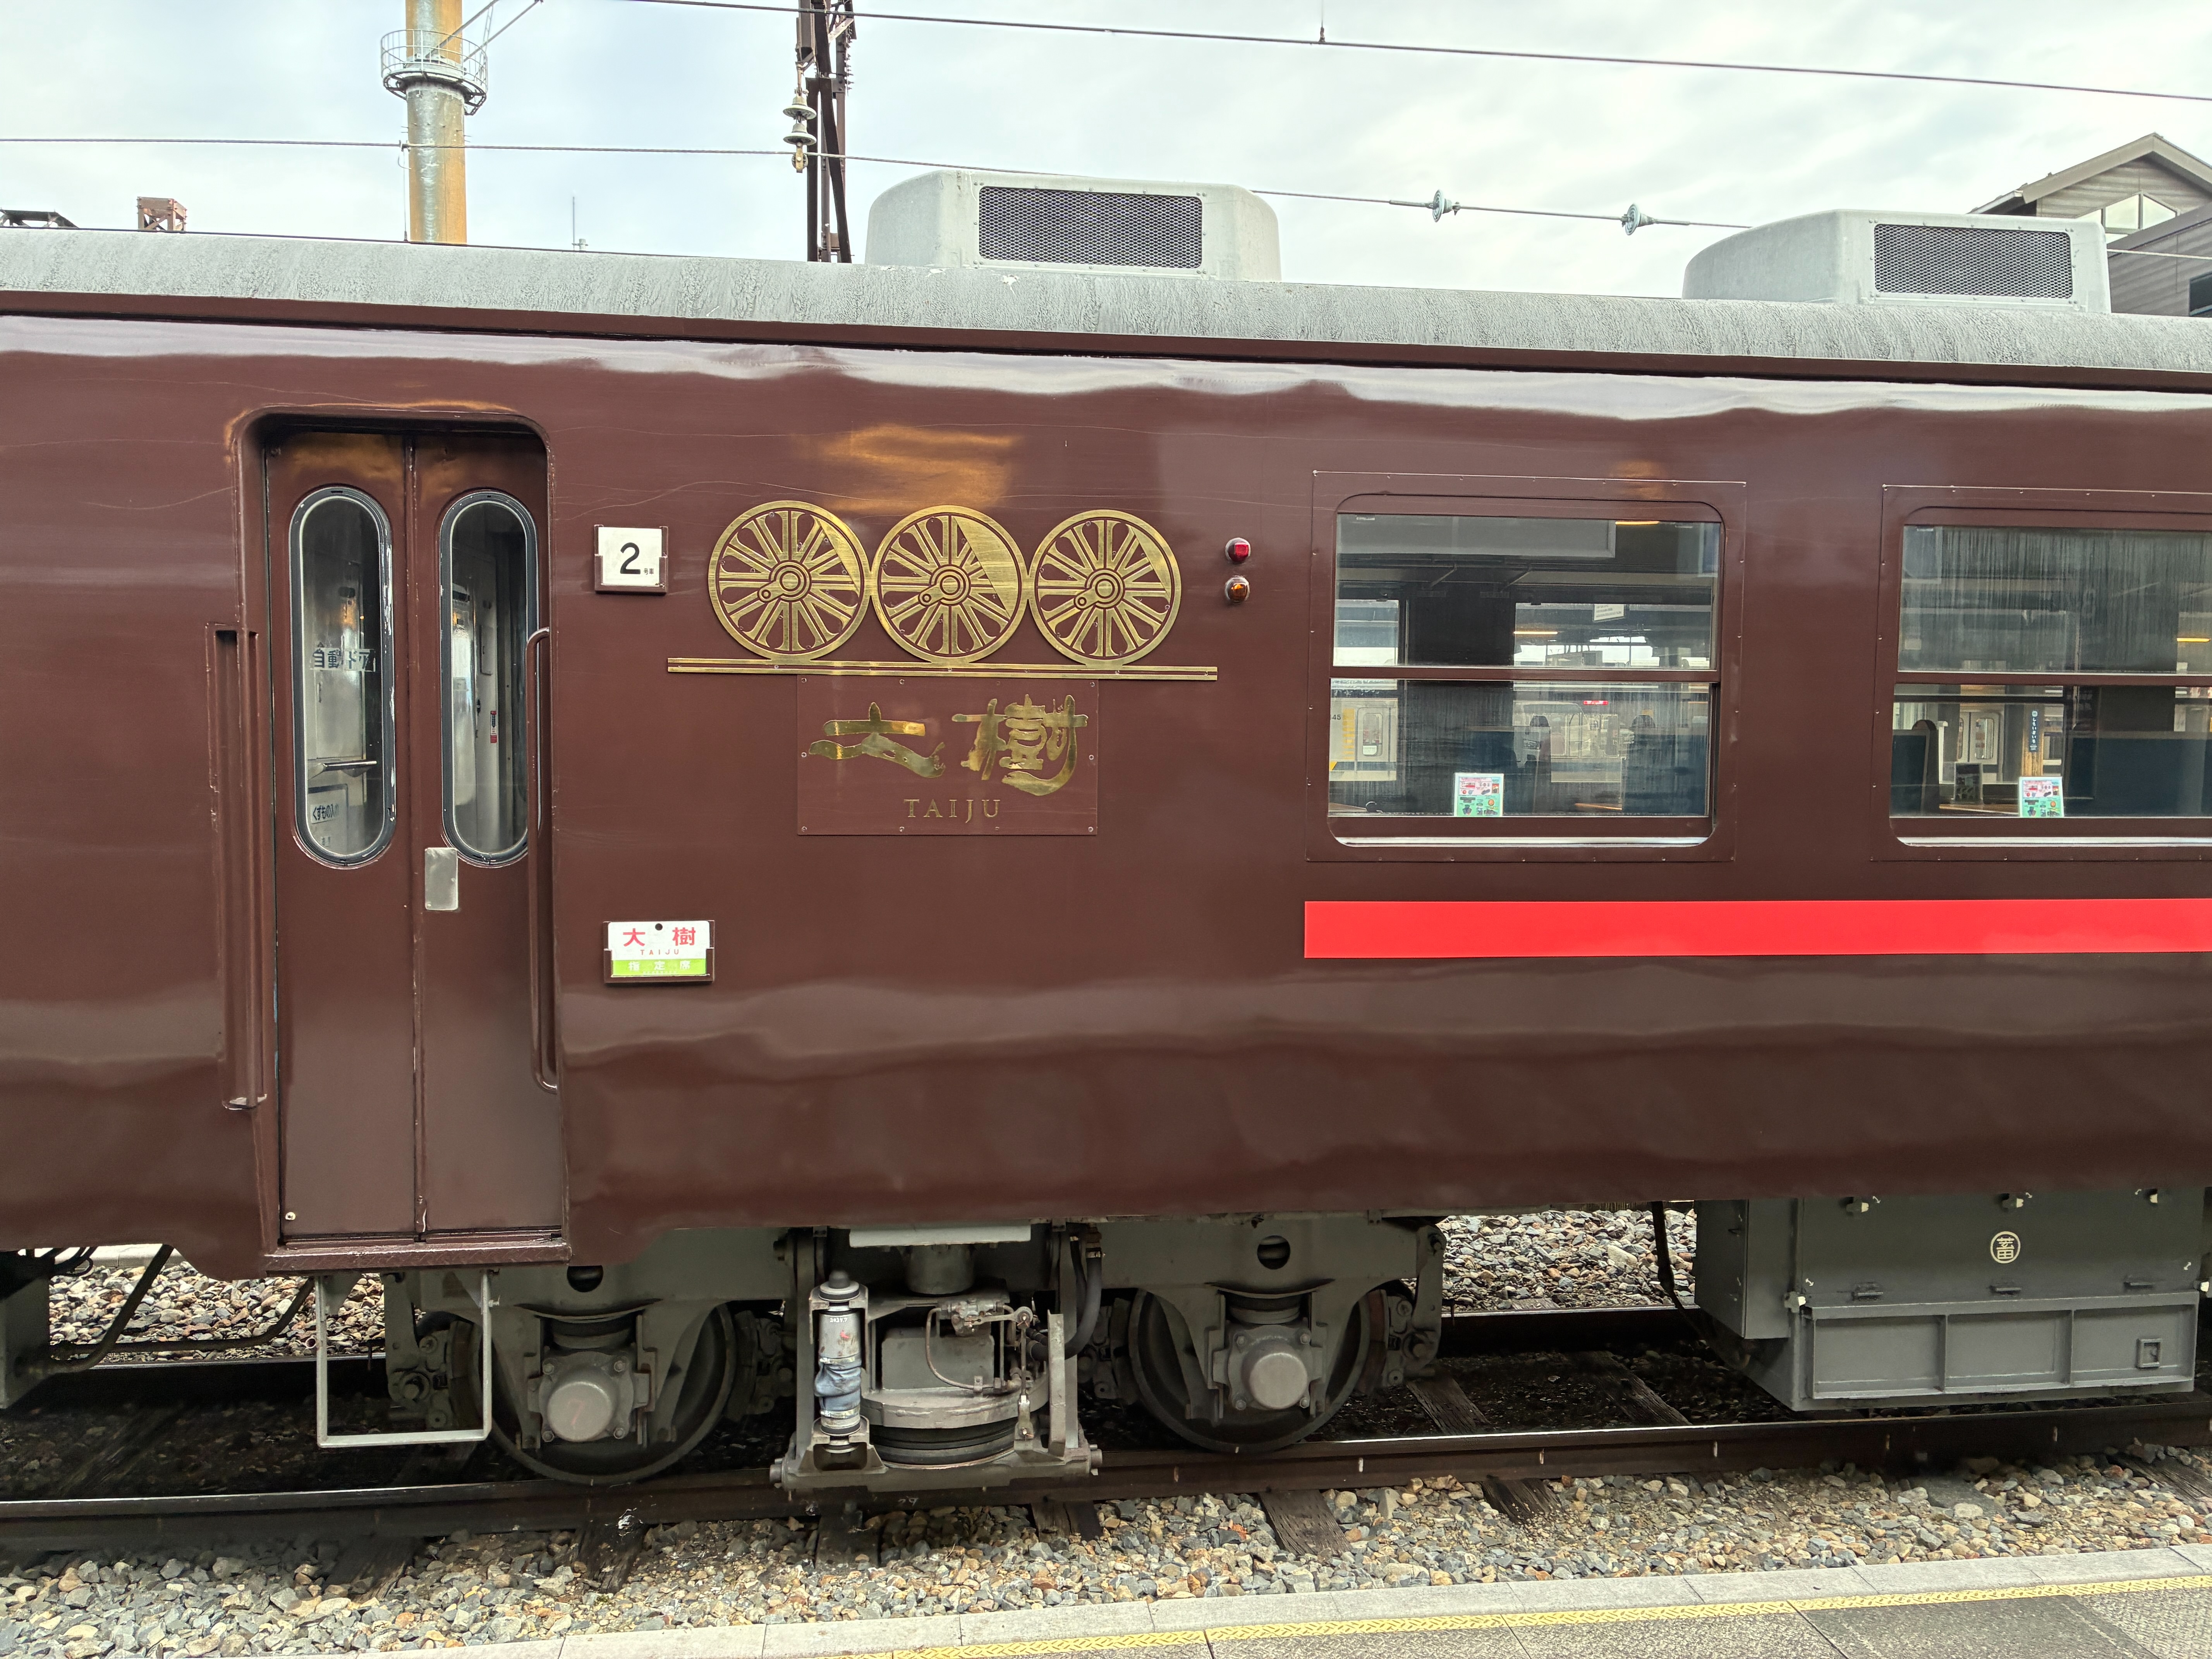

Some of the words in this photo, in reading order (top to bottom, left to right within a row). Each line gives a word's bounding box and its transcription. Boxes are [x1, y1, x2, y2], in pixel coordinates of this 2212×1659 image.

[620, 542, 641, 574] 2
[809, 694, 1089, 796] 大樹
[903, 799, 1001, 823] TAIJU
[623, 927, 696, 947] 大樹
[628, 960, 691, 971] 指定席
[1996, 1237, 2015, 1259] 蓄
